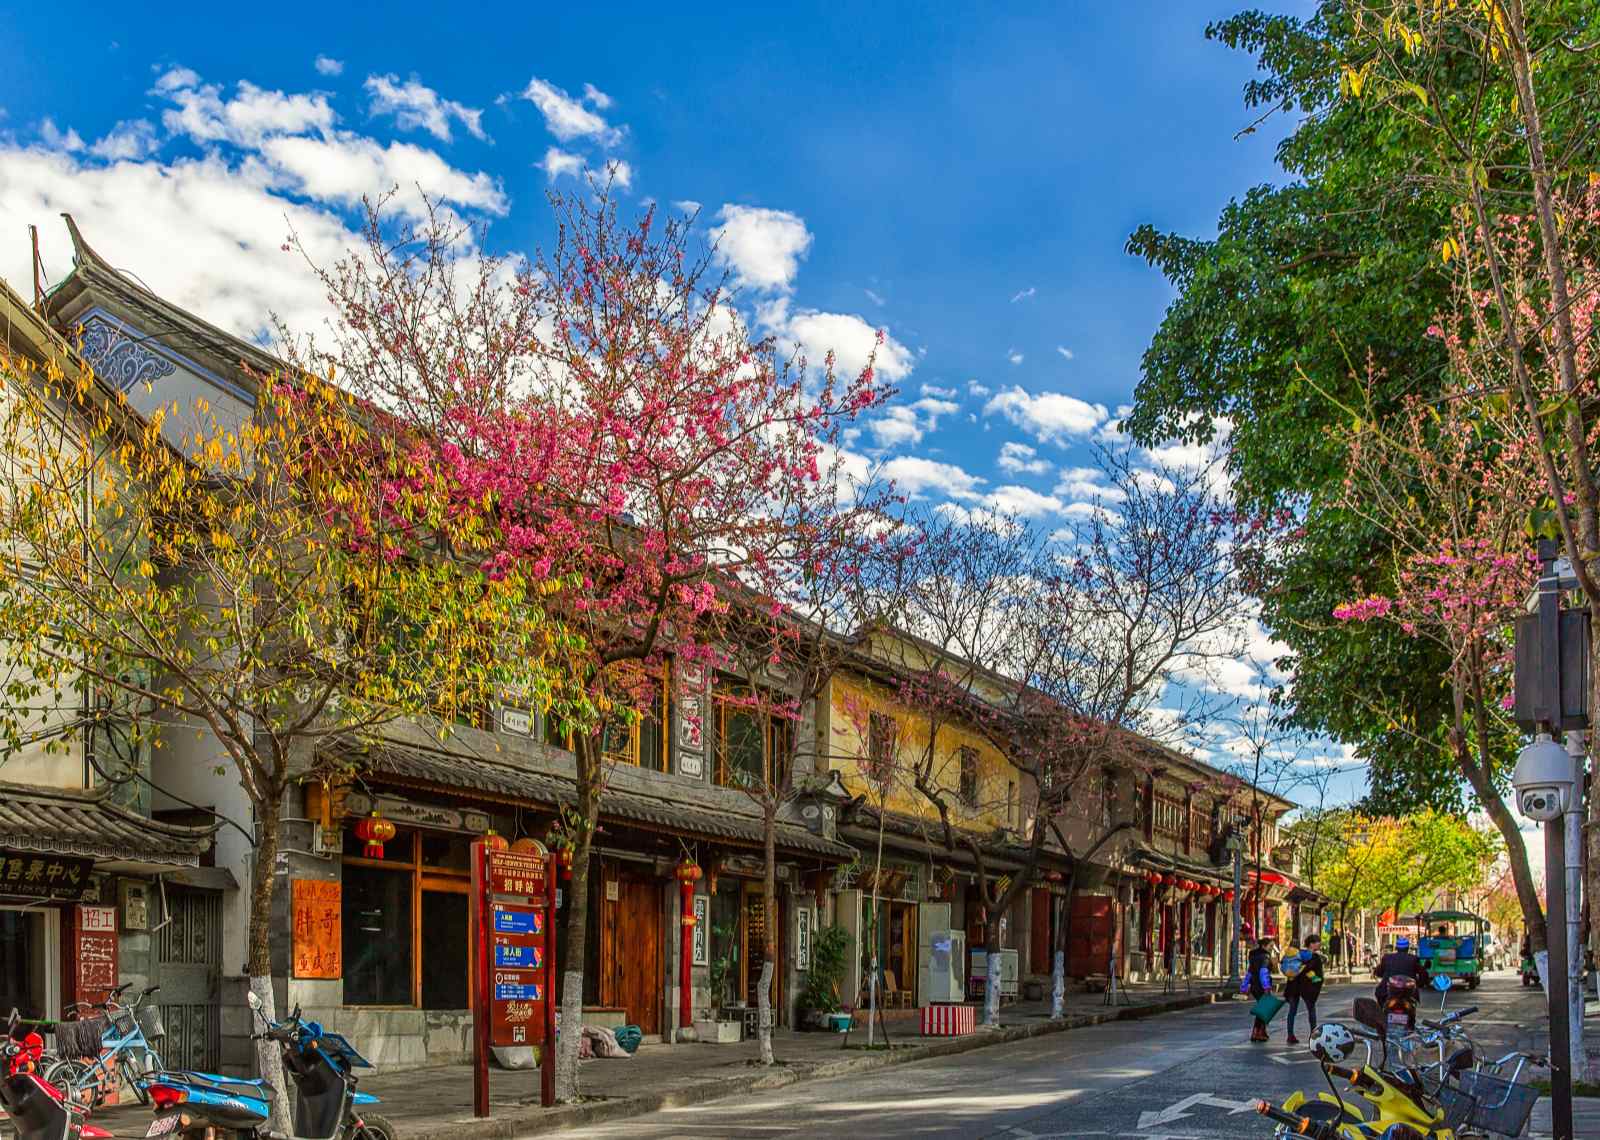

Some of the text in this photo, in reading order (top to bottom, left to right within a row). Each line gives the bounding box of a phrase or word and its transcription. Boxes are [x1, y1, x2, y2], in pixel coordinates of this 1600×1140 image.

[504, 879, 534, 894] 招呼站
[83, 907, 113, 929] 招工
